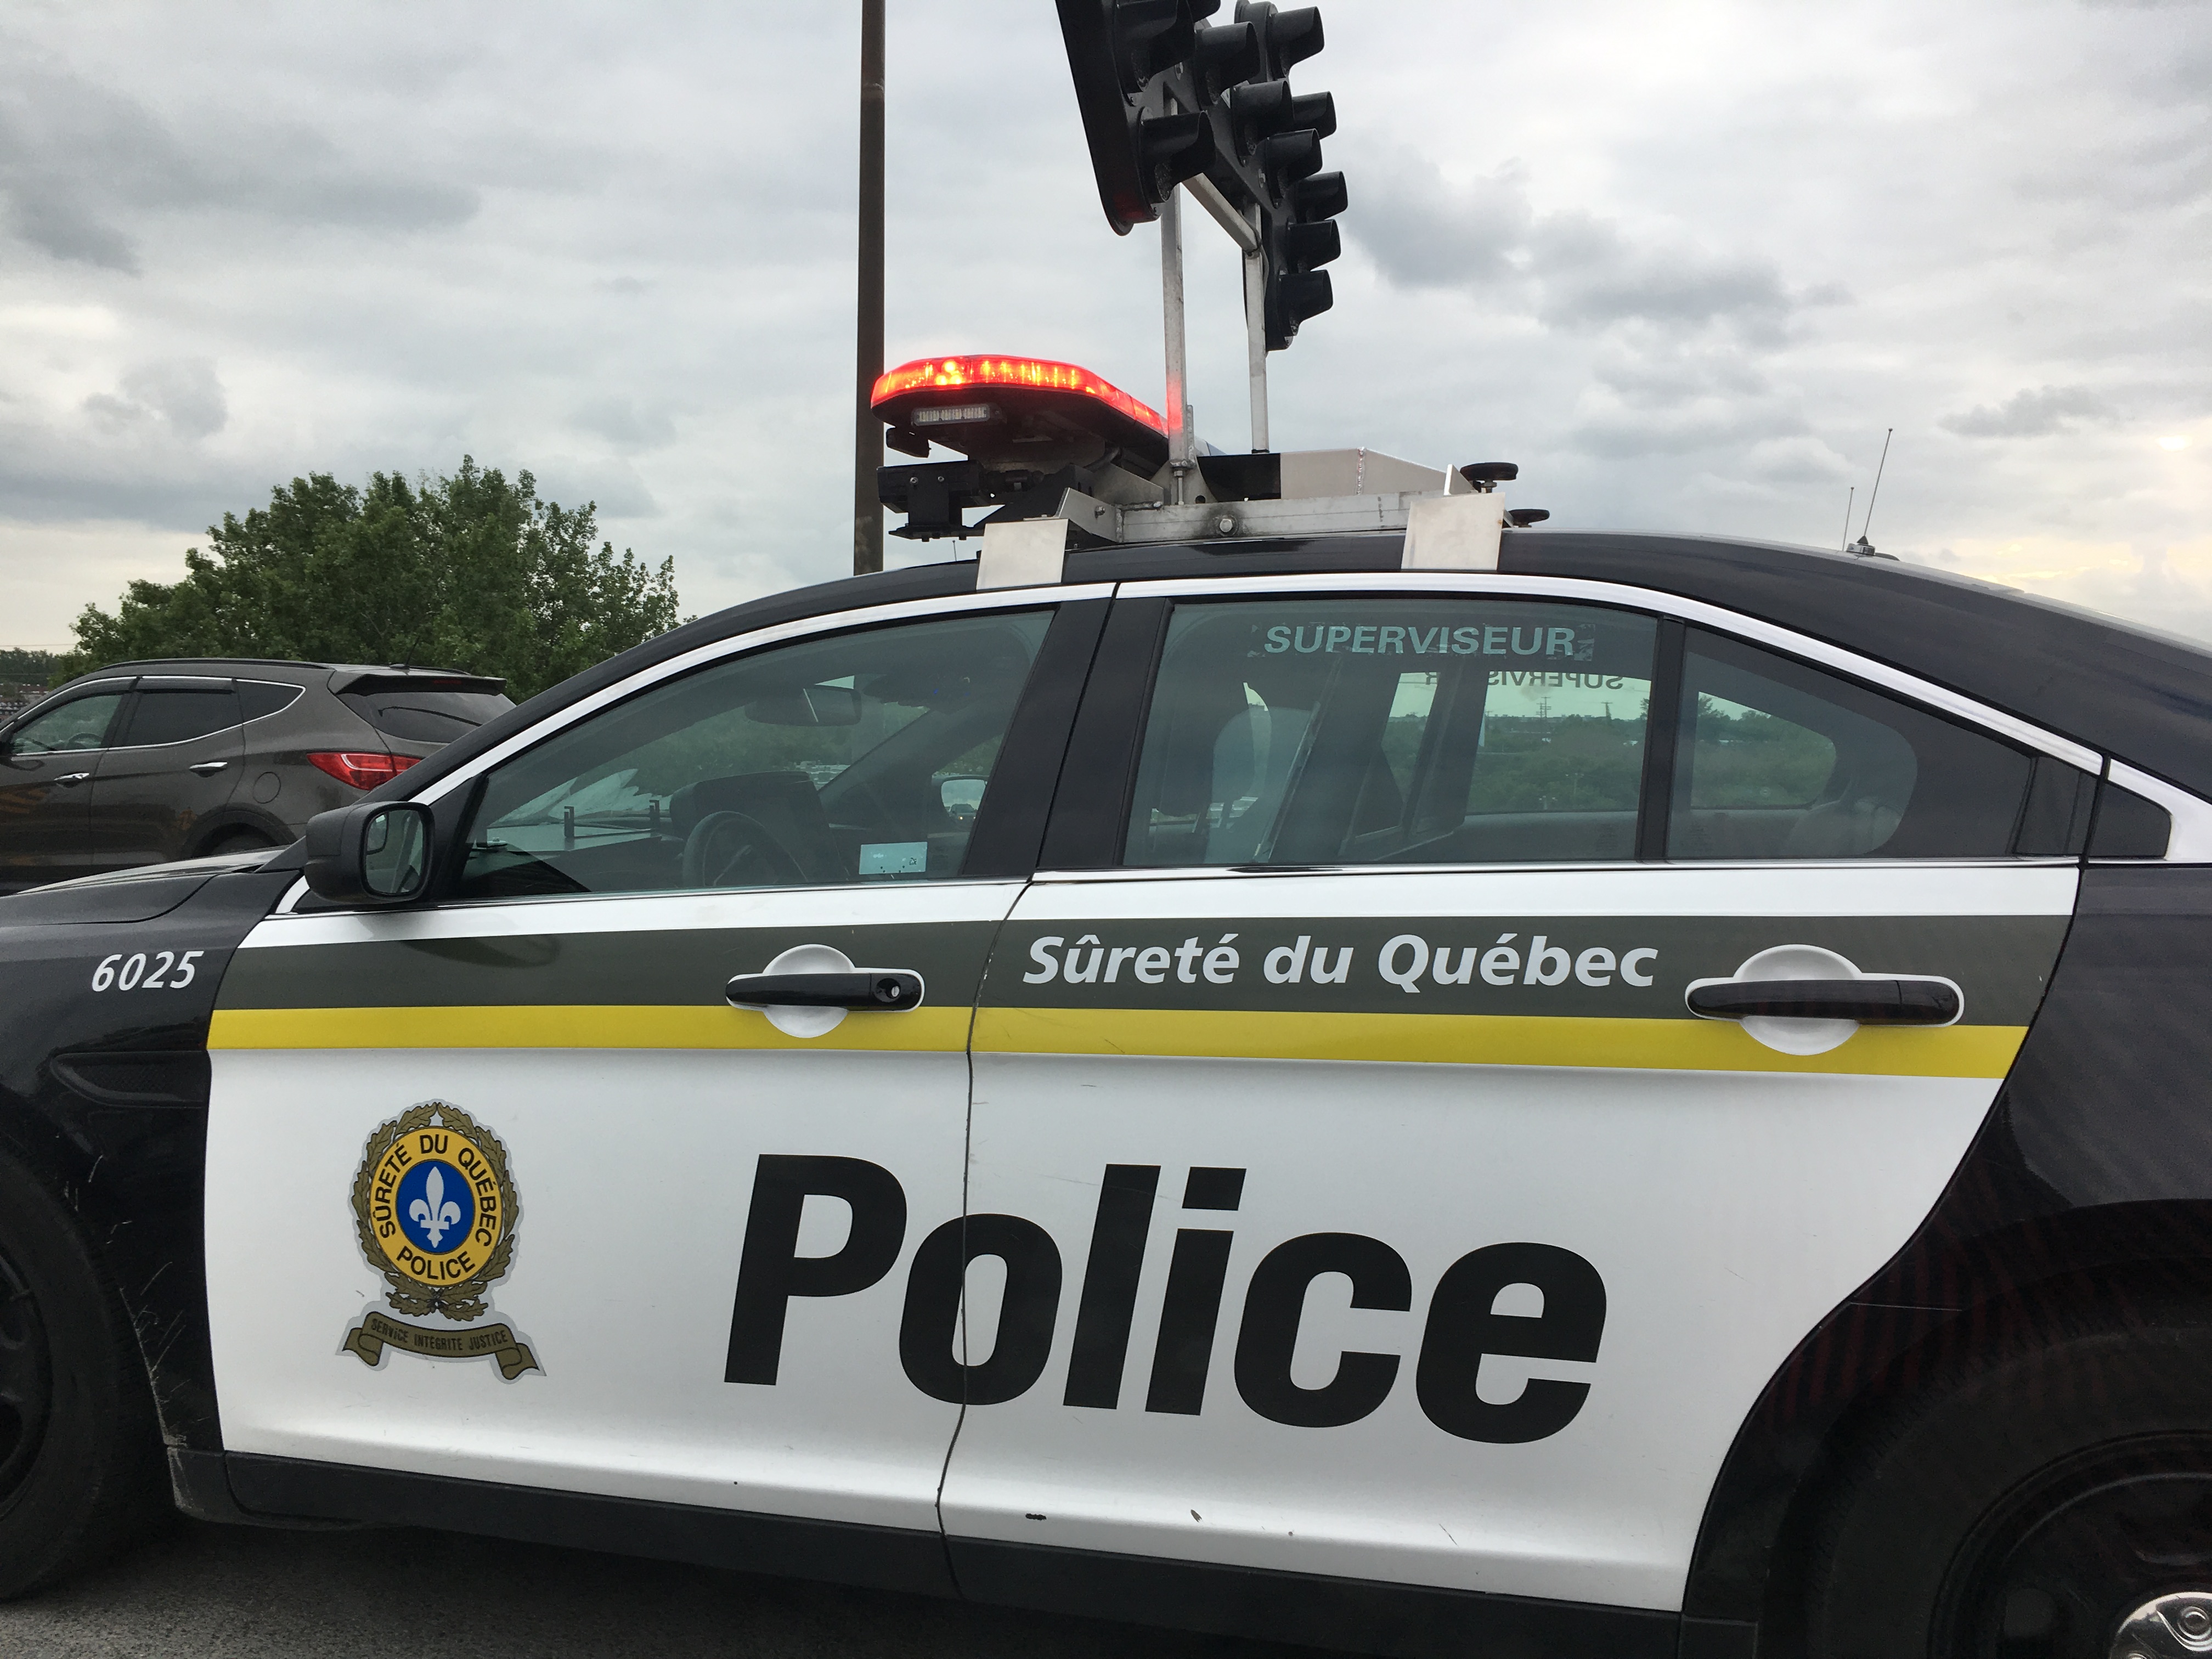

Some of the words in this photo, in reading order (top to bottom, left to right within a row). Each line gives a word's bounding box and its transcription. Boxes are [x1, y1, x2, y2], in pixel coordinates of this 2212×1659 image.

[1263, 625, 1575, 656] SUPERVISEUR
[92, 951, 204, 992] 6025
[1023, 933, 1239, 985] Sûreté
[1263, 935, 1354, 984] du
[1378, 934, 1658, 994] Québec
[420, 1133, 448, 1154] DU
[458, 1148, 498, 1246] QUÉBEC
[397, 1245, 476, 1280] POLICE
[724, 1154, 1607, 1444] Police
[468, 1330, 508, 1350] JUSTICE
